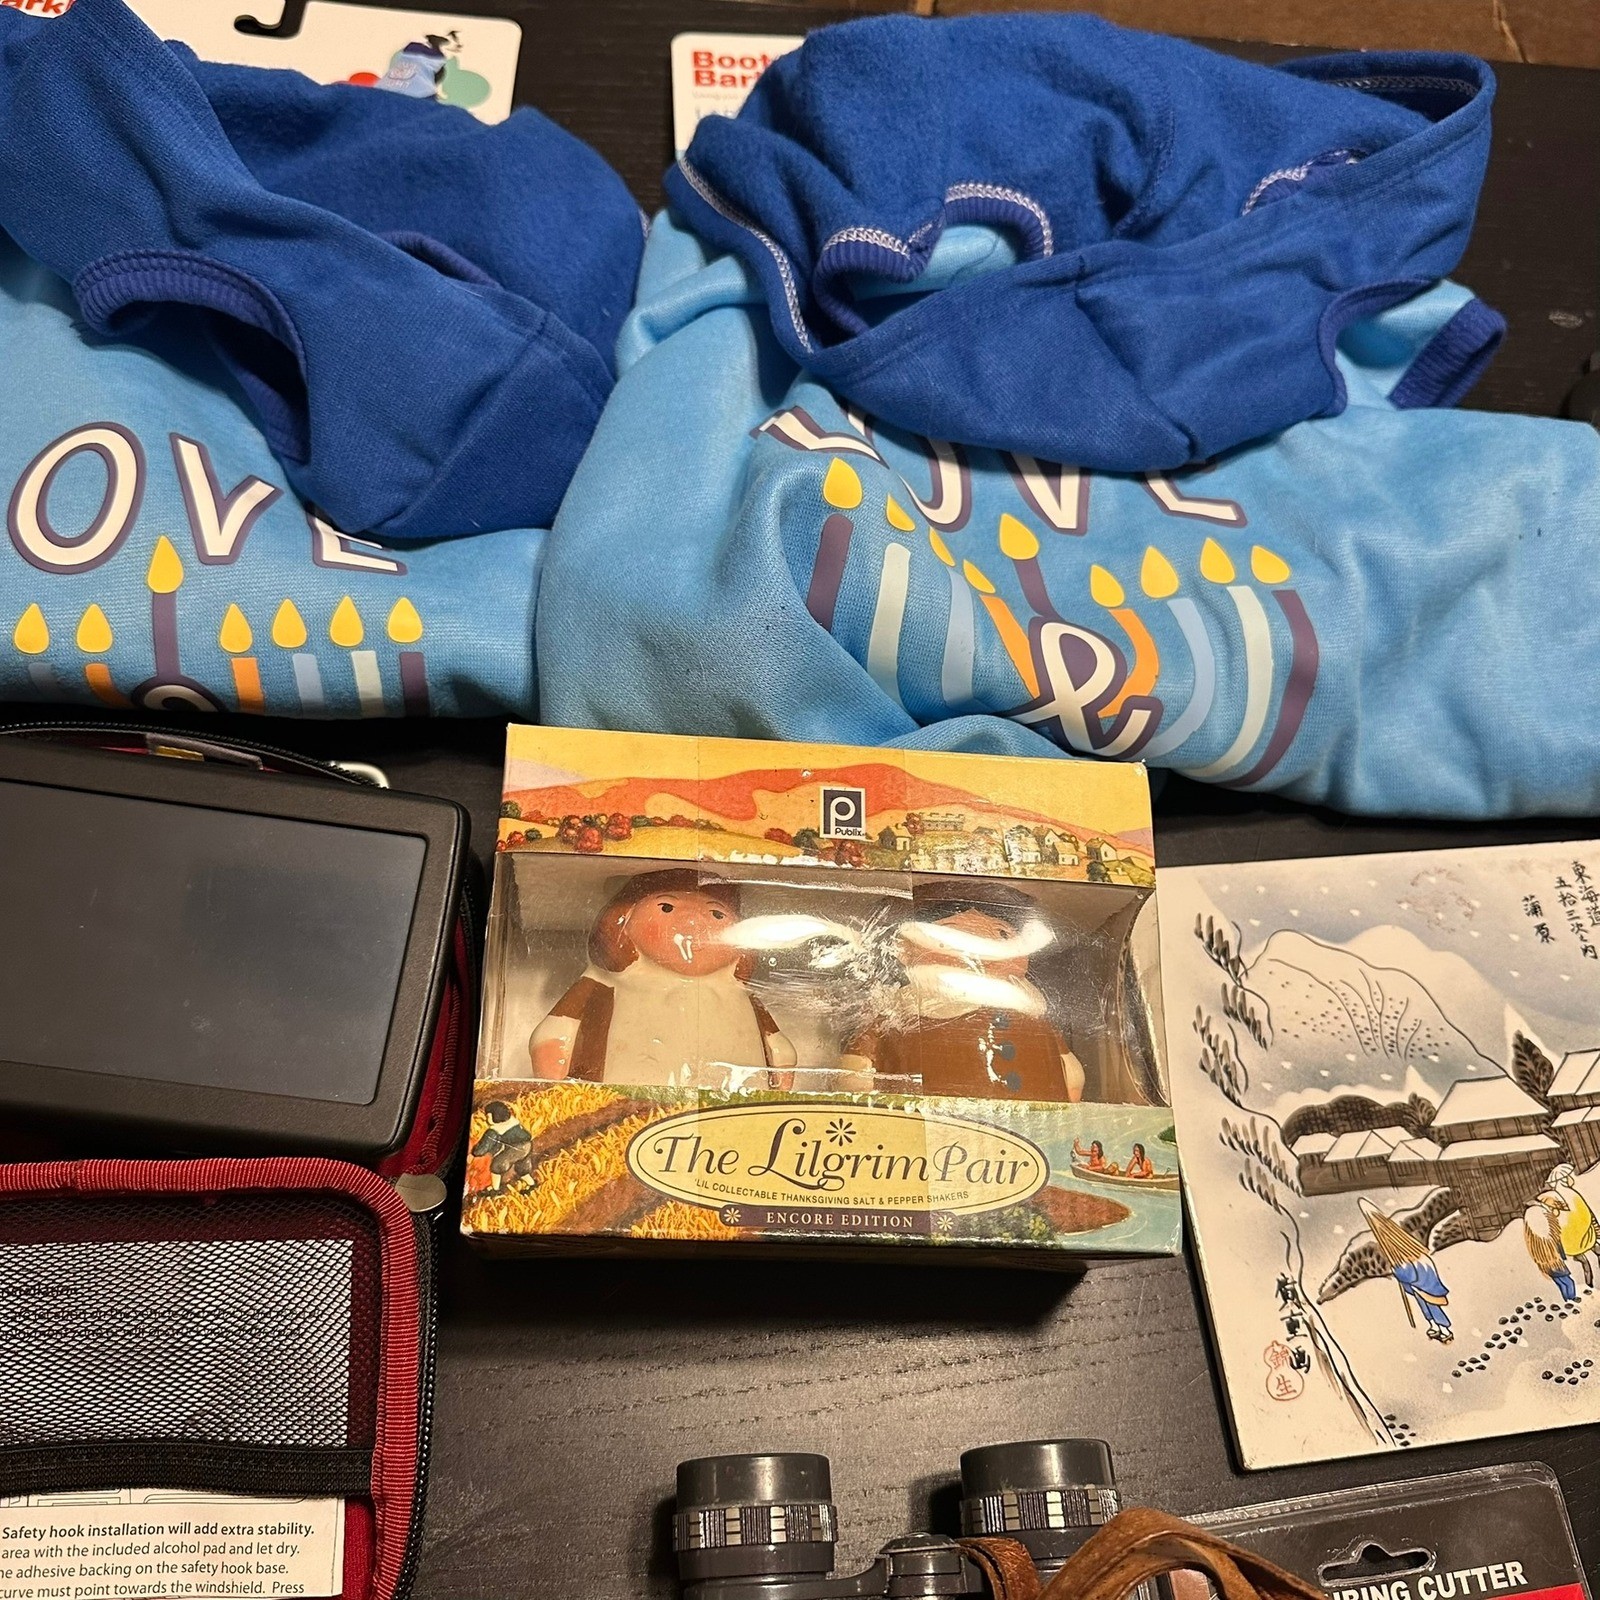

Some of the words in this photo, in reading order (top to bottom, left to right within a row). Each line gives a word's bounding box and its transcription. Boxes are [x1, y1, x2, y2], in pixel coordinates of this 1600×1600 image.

[694, 70, 761, 87] Bar
[835, 827, 862, 836] Publix
[653, 1133, 740, 1175] The
[748, 1118, 930, 1192] Lilgrim
[933, 1141, 1030, 1185] Pair
[712, 1182, 778, 1200] COLLECTABLE
[781, 1193, 850, 1205] THANKSGIVING
[853, 1195, 876, 1206] SALT
[878, 1196, 885, 1206] &
[887, 1195, 924, 1205] PEPPER
[927, 1190, 970, 1204] SHAKERS
[766, 1212, 833, 1226] ENCORE
[841, 1214, 914, 1228] EDITION
[2, 1526, 46, 1541] Safety
[50, 1525, 85, 1537] hook
[88, 1523, 164, 1537] installation
[168, 1522, 191, 1535] will
[194, 1522, 218, 1535] add
[221, 1525, 254, 1535] extra
[257, 1523, 315, 1537] stability.
[1, 1549, 30, 1559] area
[34, 1544, 63, 1558] with
[67, 1544, 89, 1557] the
[92, 1542, 150, 1556] included
[153, 1541, 200, 1555] alcohol
[203, 1542, 226, 1556] pad
[229, 1542, 253, 1555] and
[256, 1542, 273, 1554] let
[276, 1542, 300, 1557] dry.
[16, 1565, 76, 1579] adhesive
[79, 1563, 132, 1578] backing
[135, 1564, 153, 1575] on
[157, 1561, 178, 1574] the
[181, 1560, 218, 1576] safety
[221, 1561, 252, 1574] hook
[256, 1561, 289, 1574] base.
[37, 1586, 71, 1598] must
[74, 1583, 110, 1599] point
[113, 1581, 167, 1595] towards
[171, 1580, 193, 1593] the
[195, 1580, 266, 1594] windshield.
[272, 1581, 305, 1594] Press
[1417, 1560, 1529, 1600] CUTTER
